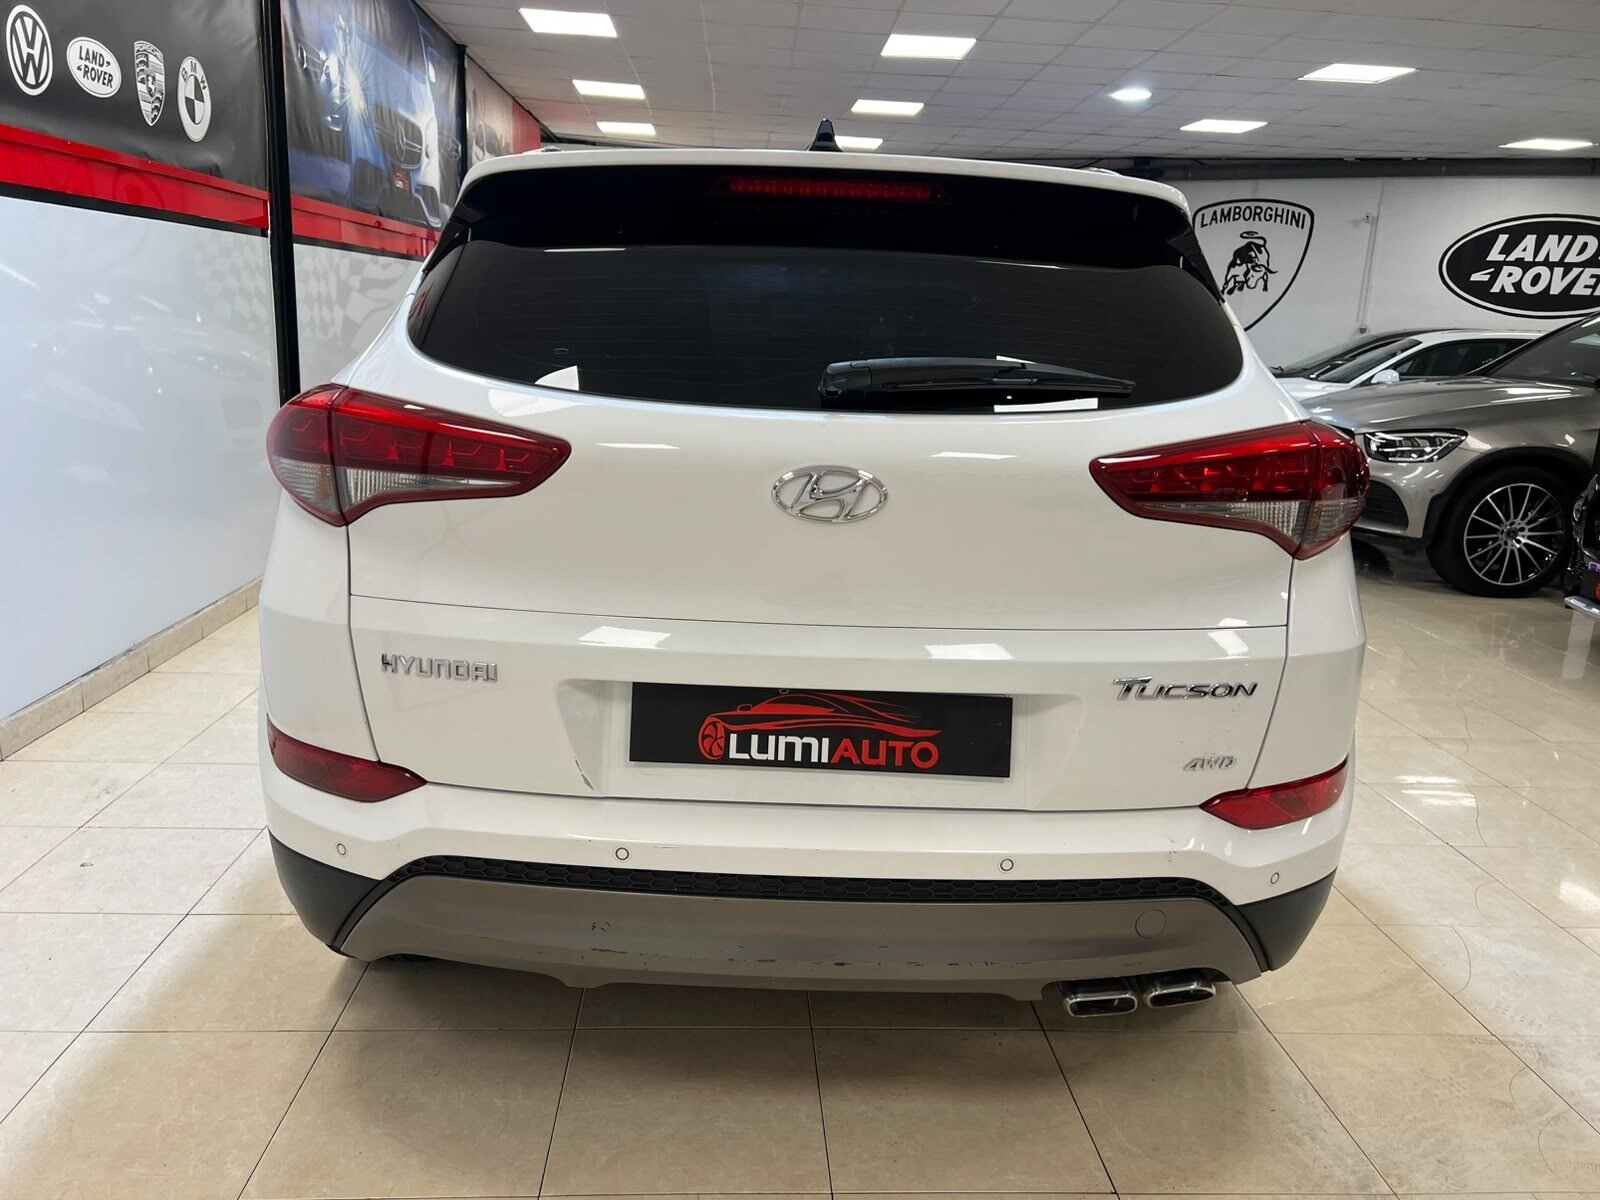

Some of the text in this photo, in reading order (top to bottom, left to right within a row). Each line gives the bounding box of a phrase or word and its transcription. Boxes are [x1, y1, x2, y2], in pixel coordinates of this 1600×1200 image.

[79, 45, 105, 67] LAND
[82, 64, 113, 88] ROVER
[1200, 205, 1306, 229] LAMBORGHINI
[1486, 234, 1599, 262] LAND
[1489, 265, 1600, 296] ROVE
[381, 653, 498, 683] HYUNDAI
[1113, 676, 1258, 700] TUCSON
[1183, 755, 1237, 772] 4WD
